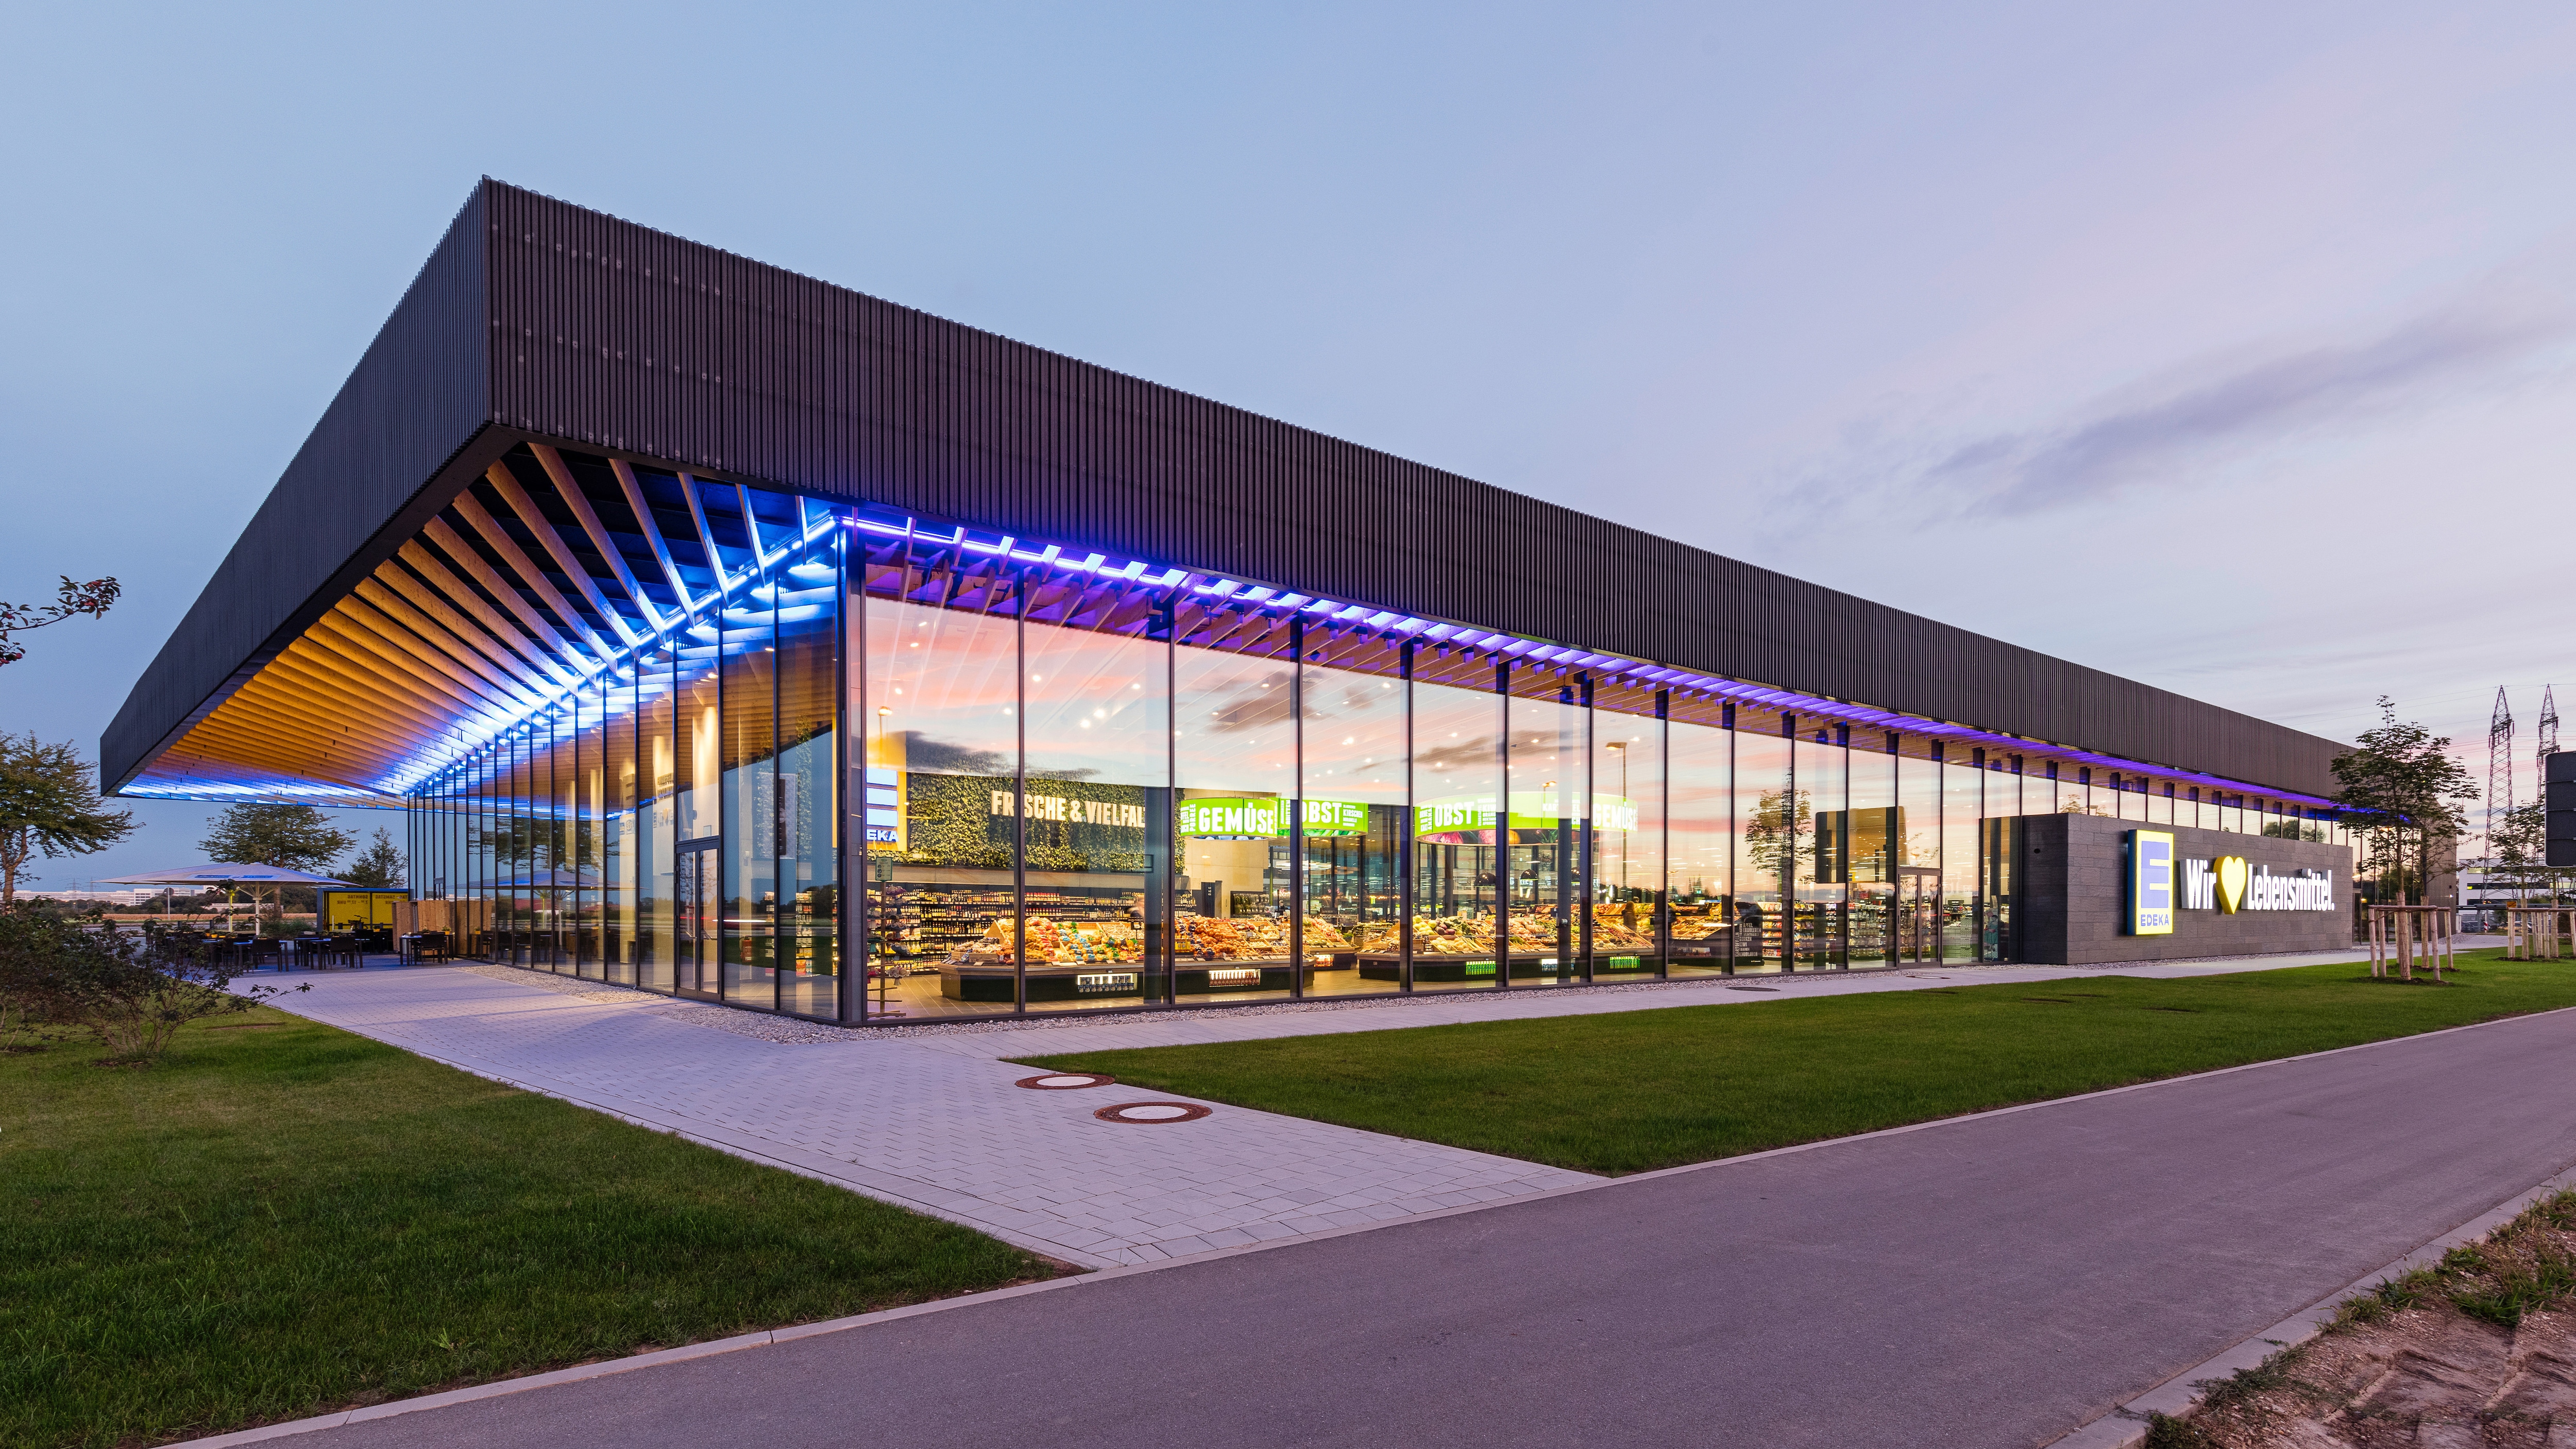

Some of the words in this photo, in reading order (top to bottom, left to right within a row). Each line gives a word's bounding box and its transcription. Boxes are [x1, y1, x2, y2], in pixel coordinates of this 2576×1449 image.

[991, 790, 1066, 821] FRSCHE
[1070, 800, 1082, 822] &
[1084, 801, 1145, 828] VIELFAL
[1198, 802, 1274, 834] GEMÜSE
[1343, 808, 1363, 818] KIRSCHEN
[1435, 801, 1475, 827] OBST
[1593, 801, 1637, 831] GEMÜSE
[2185, 858, 2217, 909] Wir
[2247, 863, 2335, 911] Lebensmittel.
[2141, 914, 2170, 926] EDEKA
